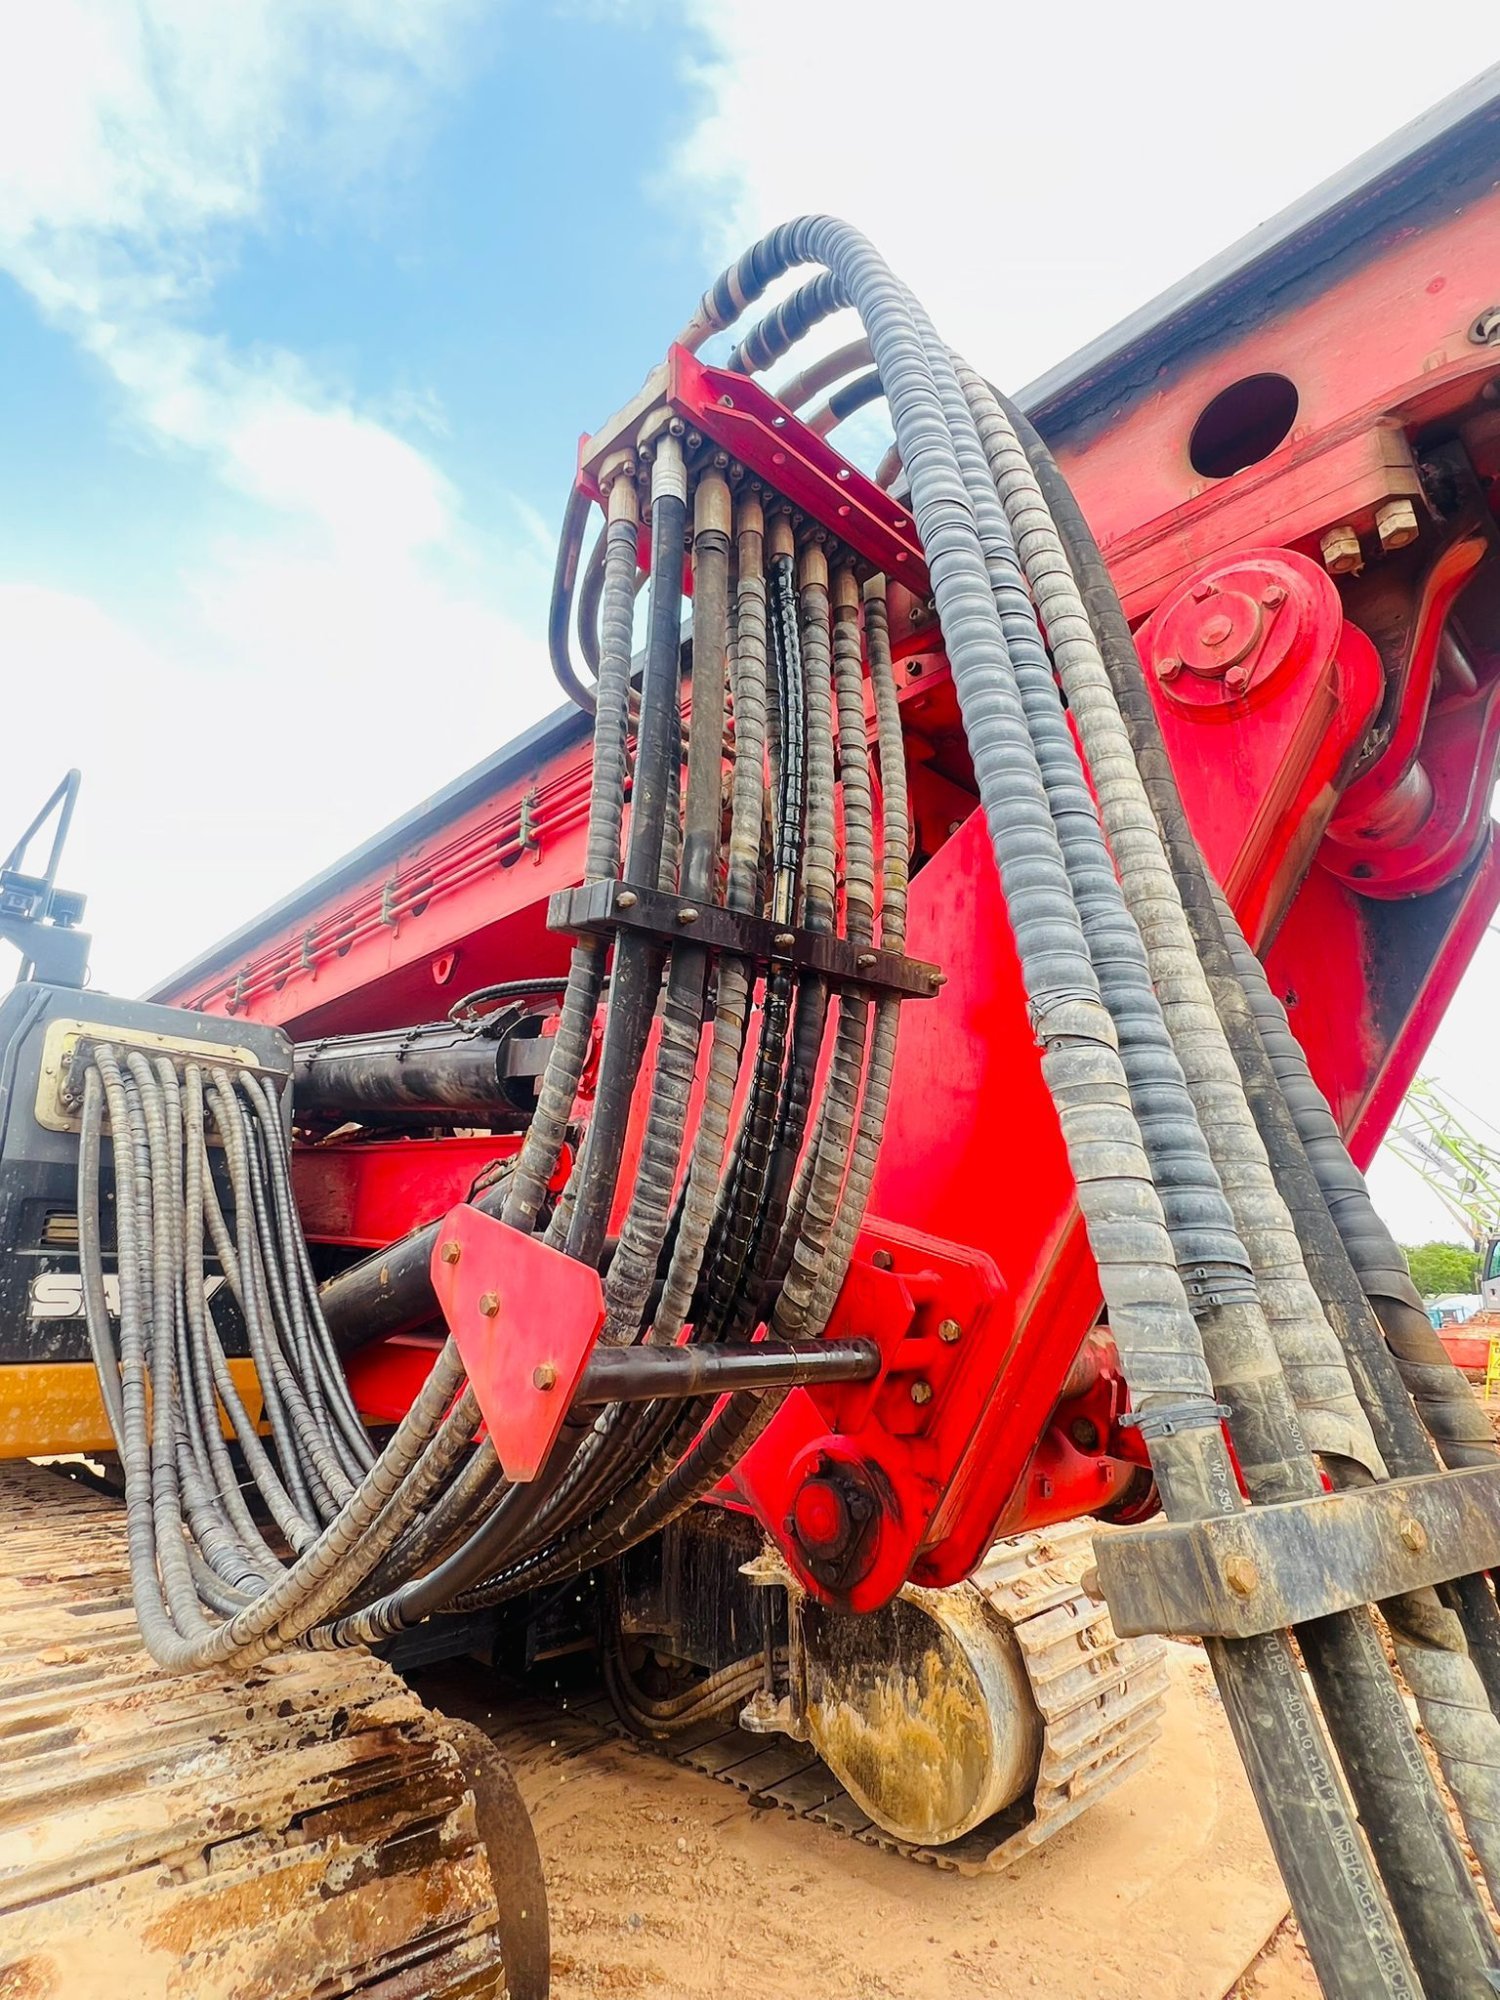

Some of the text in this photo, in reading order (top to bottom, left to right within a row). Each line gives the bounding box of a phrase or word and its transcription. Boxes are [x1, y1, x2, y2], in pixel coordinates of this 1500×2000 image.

[1289, 1422, 1306, 1452] 5070
[1217, 1487, 1235, 1513] 350
[1270, 1654, 1289, 1676] psi
[1332, 1825, 1364, 1880] MSHA
